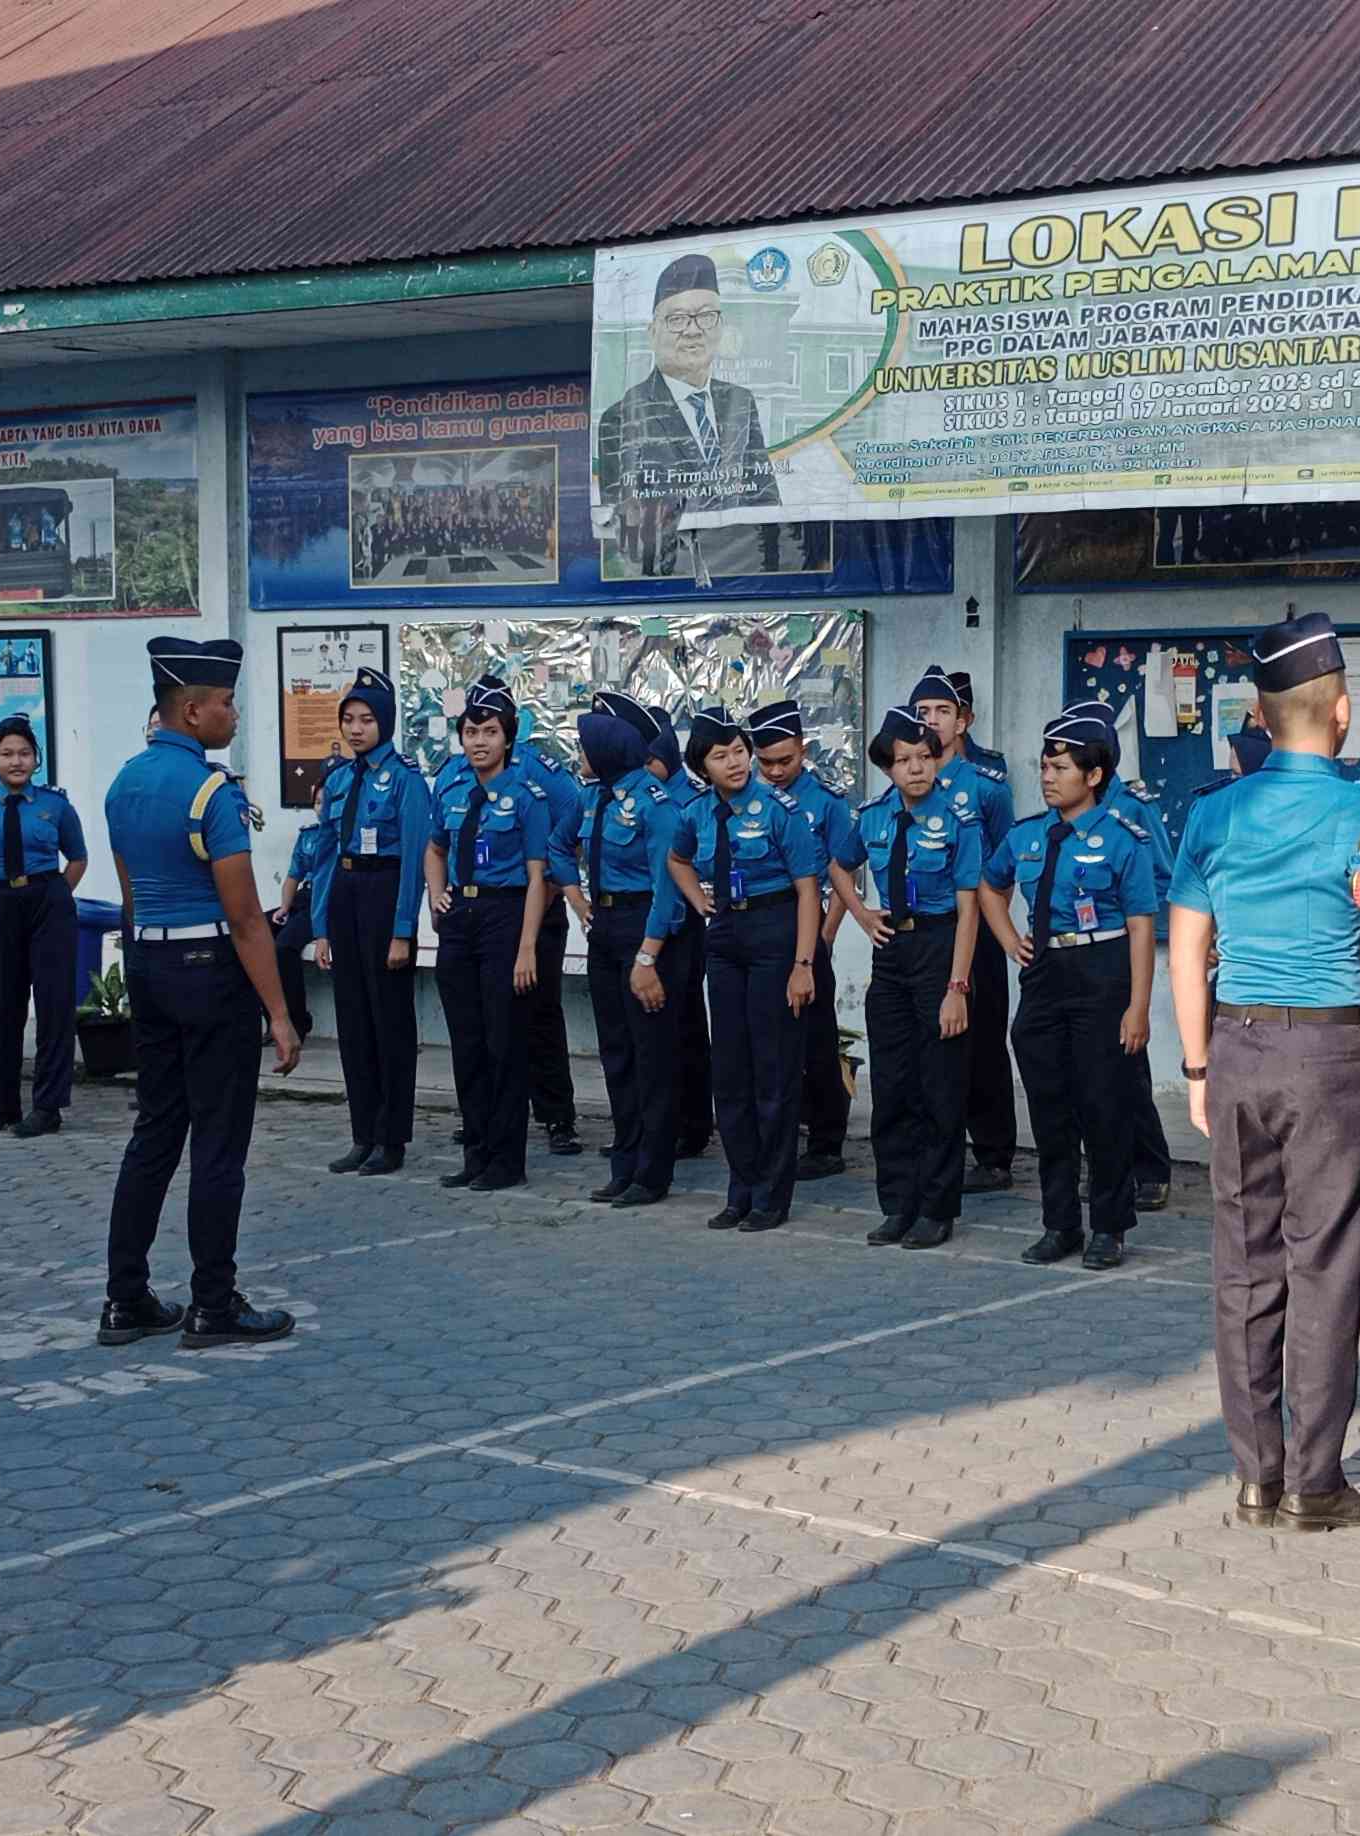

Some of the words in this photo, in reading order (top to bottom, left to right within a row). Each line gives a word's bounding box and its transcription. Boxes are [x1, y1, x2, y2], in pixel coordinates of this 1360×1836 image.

[959, 192, 1298, 274] LOKASI
[871, 273, 1053, 314] PRAKTIK
[918, 310, 1070, 339] MAHASISWA
[1080, 297, 1210, 326] PROGRAM
[945, 340, 993, 359] PPG
[1002, 330, 1088, 355] DALAM
[1097, 321, 1218, 347] JABATAN
[874, 357, 1057, 395] UNIVERSITAS
[1065, 347, 1184, 381] MUSLIM
[507, 384, 583, 409] adalah
[944, 392, 1008, 413] SIKLUS
[1016, 391, 1024, 408] 1
[1046, 382, 1124, 407] Tanggal
[1130, 383, 1141, 400] 6
[1149, 376, 1252, 399] Desember
[1258, 373, 1312, 393] 2023
[1320, 370, 1344, 389] sd
[944, 411, 1008, 431] SIKLUS
[1014, 411, 1025, 427] 2
[1046, 401, 1123, 425] Tanggal
[1130, 402, 1155, 420] 17
[1161, 399, 1240, 417] Januari
[1247, 394, 1301, 413] 2024
[1309, 391, 1333, 410] sd
[1342, 391, 1352, 408] 1
[32, 426, 62, 441] YANG
[68, 424, 94, 439] BISA
[99, 421, 124, 435] KITA
[312, 425, 365, 449] yang
[371, 420, 416, 441] bisa
[423, 417, 483, 438] kamu
[491, 410, 588, 440] gunakan
[909, 436, 975, 452] Sekolah
[991, 434, 1028, 447] SMK
[1032, 426, 1166, 444] PENERBANGAN
[1171, 420, 1263, 437] ANGKASA
[1, 453, 26, 467] KITA
[643, 469, 660, 484] H.
